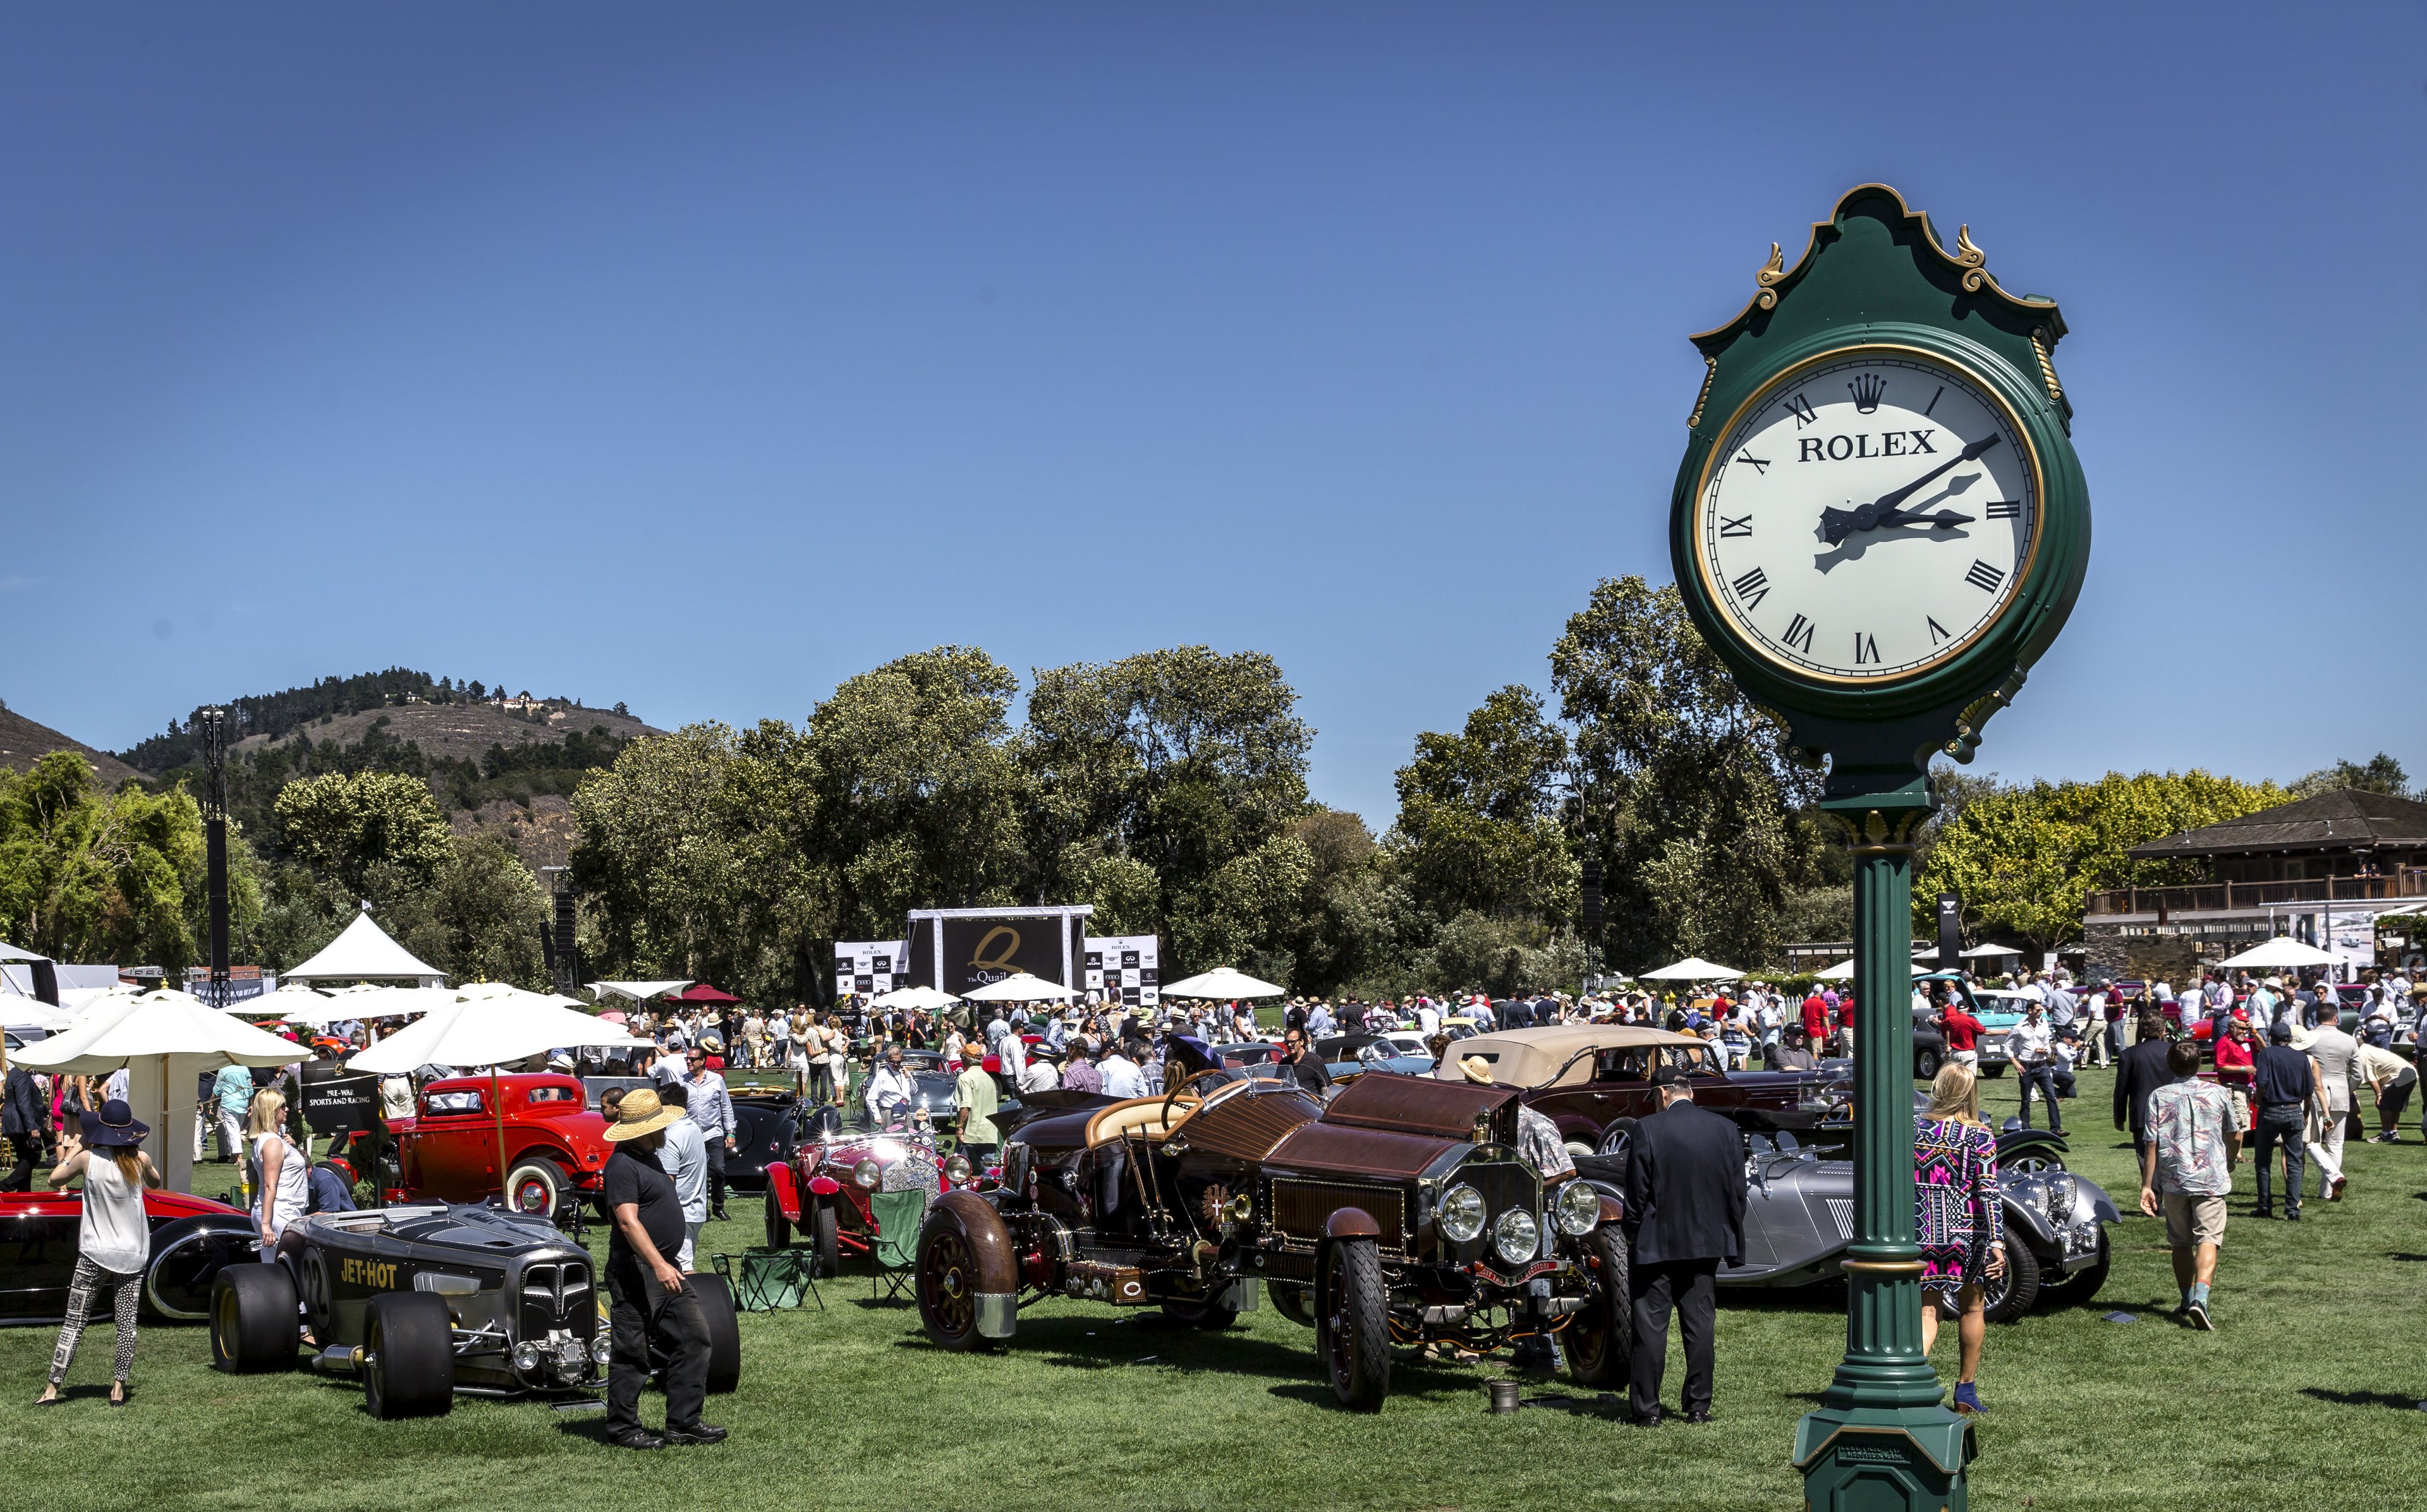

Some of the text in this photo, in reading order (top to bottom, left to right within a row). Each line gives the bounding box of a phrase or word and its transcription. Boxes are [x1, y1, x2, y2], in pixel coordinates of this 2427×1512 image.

[1782, 392, 1818, 431] XI
[1736, 447, 1771, 475] X
[1797, 429, 1938, 463] ROLEX
[1986, 499, 2020, 520] III
[1720, 514, 1752, 538] IX
[1732, 566, 1771, 612] VIII
[1780, 613, 1815, 654] VII
[1926, 614, 1952, 646] V
[1854, 632, 1881, 664] VI
[977, 971, 1006, 985] Quail
[309, 1098, 332, 1106] SPORTS
[348, 1096, 370, 1104] RACING
[326, 1089, 355, 1097] PRE-WAR
[303, 1259, 329, 1315] 22
[341, 1257, 397, 1290] JET-HOT
